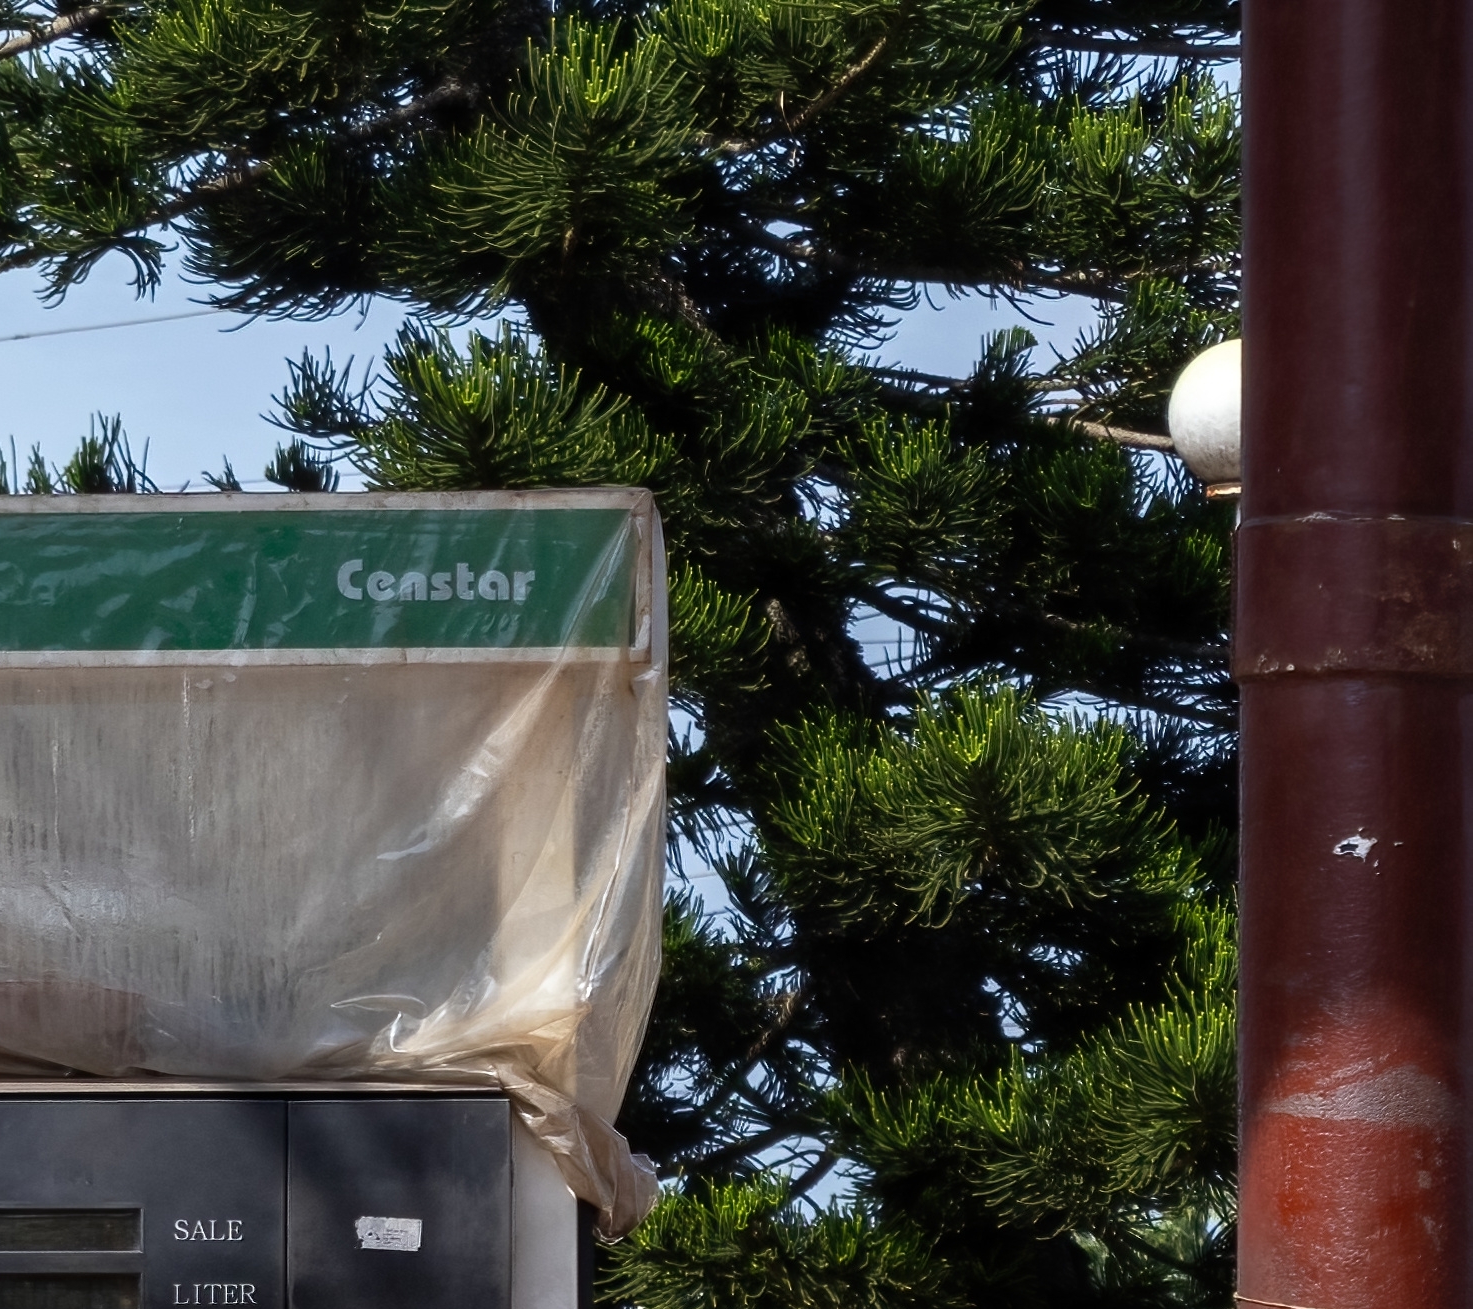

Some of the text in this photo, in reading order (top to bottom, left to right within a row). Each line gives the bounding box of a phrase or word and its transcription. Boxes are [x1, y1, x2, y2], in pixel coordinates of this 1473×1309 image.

[337, 559, 536, 602] Censtar
[173, 1219, 243, 1242] SALE
[173, 1283, 257, 1306] LITER
